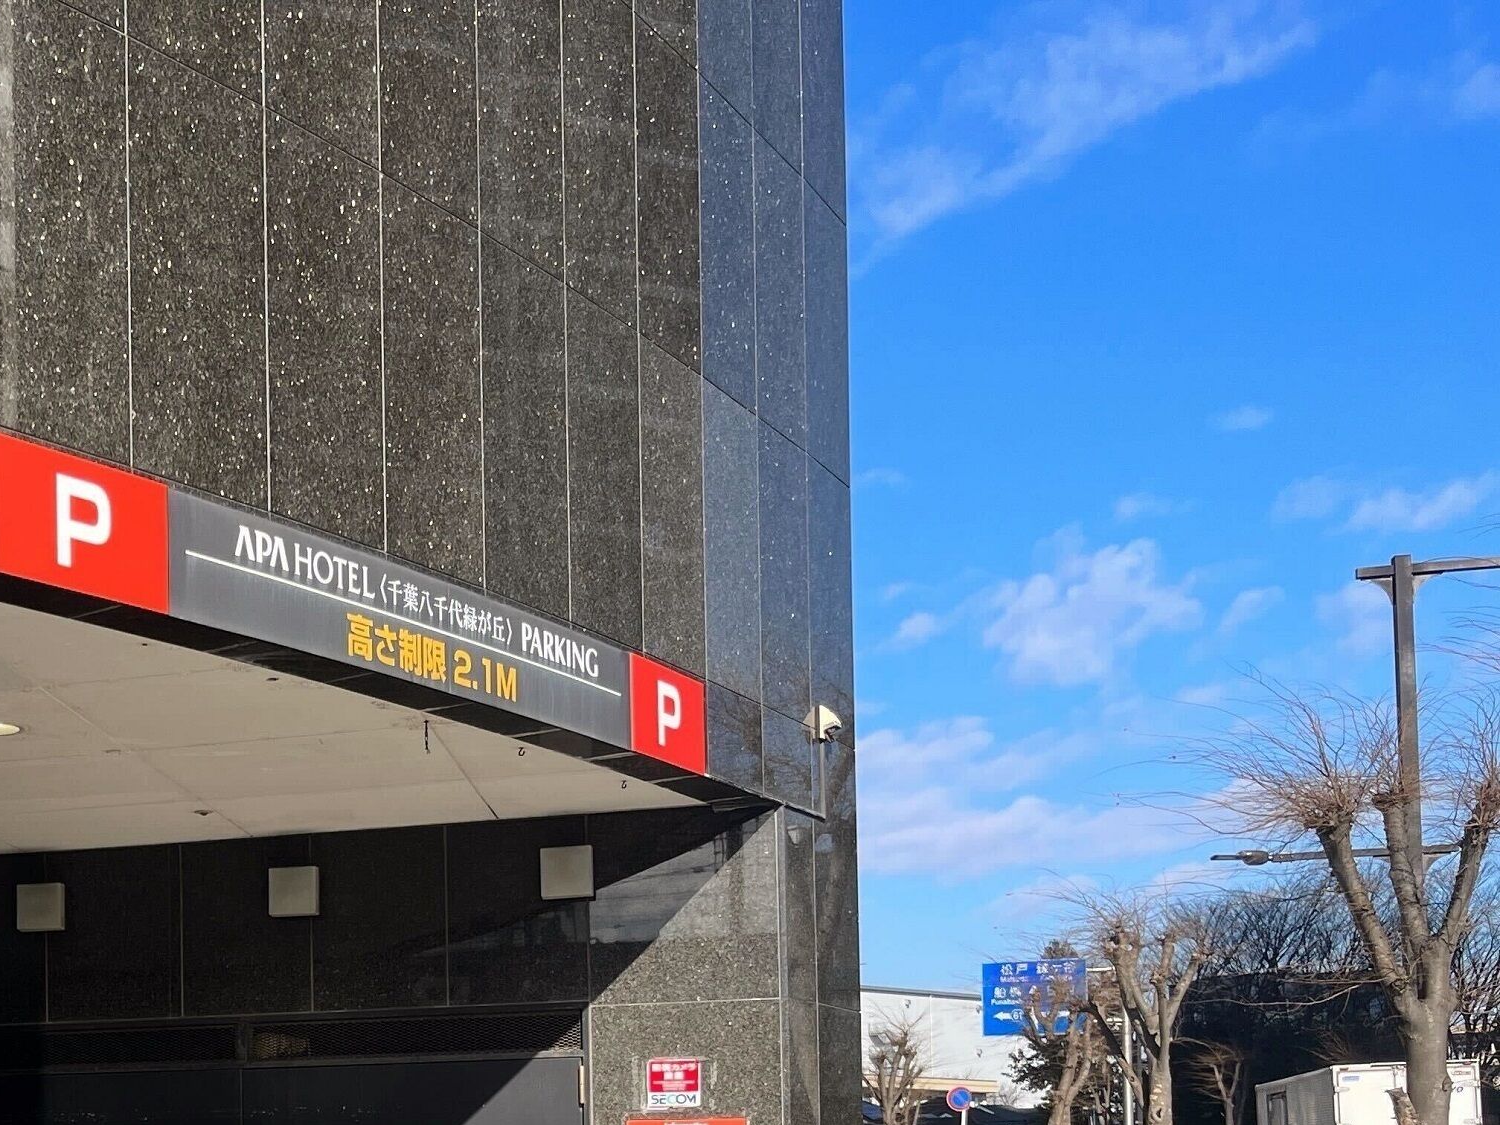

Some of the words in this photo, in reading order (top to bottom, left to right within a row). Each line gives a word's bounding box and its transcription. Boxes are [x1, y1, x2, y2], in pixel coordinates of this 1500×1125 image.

[55, 473, 113, 568] P
[234, 525, 290, 572] APA
[294, 543, 376, 600] HOTEL
[521, 622, 599, 678] PARKING
[346, 612, 447, 684] 高さ制限
[454, 649, 517, 702] 2.1M
[656, 679, 682, 747] P
[651, 1093, 696, 1105] SECOM
